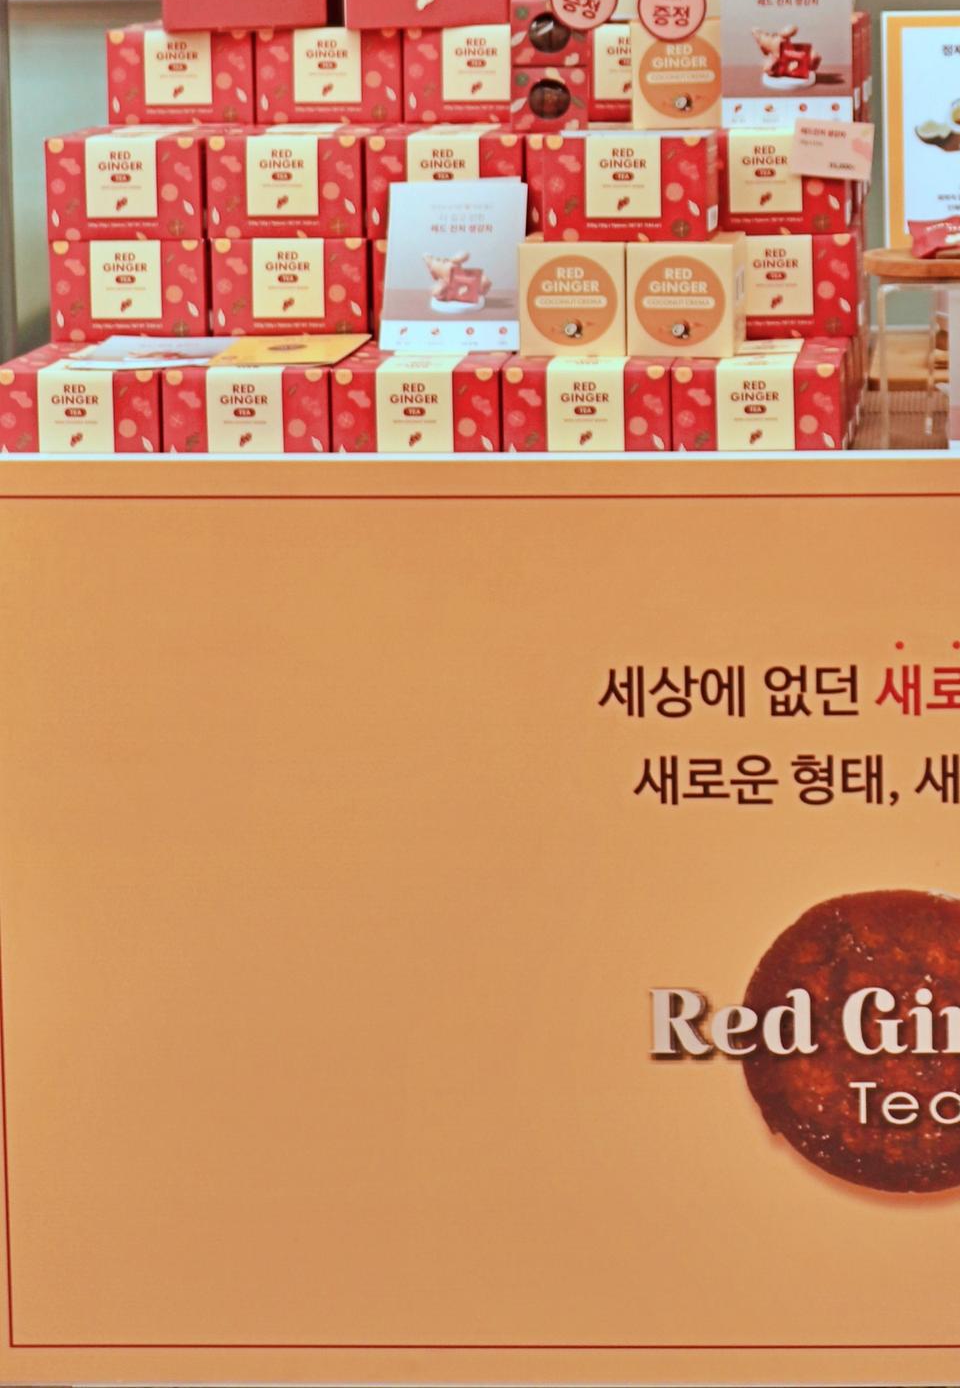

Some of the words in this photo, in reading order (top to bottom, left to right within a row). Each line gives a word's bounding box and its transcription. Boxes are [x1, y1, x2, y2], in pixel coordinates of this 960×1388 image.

[653, 5, 690, 26] 증정
[167, 41, 188, 50] RED
[317, 40, 337, 49] RED
[466, 38, 487, 46] RED
[617, 37, 632, 46] RE
[156, 51, 199, 60] GINGER
[305, 49, 348, 58] GINGER
[455, 47, 497, 57] GINGER
[666, 45, 693, 56] RED
[652, 56, 707, 68] GINGER
[109, 151, 131, 160] RED
[271, 149, 292, 158] RED
[432, 149, 454, 158] RED
[612, 148, 634, 157] RED
[754, 146, 775, 155] RED
[98, 161, 143, 171] GINGER
[259, 159, 304, 169] GINGER
[420, 158, 466, 169] GINGER
[600, 158, 646, 168] GINGER
[742, 156, 788, 166] GINGER
[114, 253, 136, 261] RED
[276, 251, 298, 260] RED
[764, 248, 786, 258] RED
[102, 262, 148, 272] GINGER
[265, 261, 310, 271] GINGER
[752, 258, 798, 269] GINGER
[557, 267, 585, 279] RED
[665, 268, 693, 280] RED
[542, 280, 599, 292] GINGER
[650, 281, 708, 293] GINGER
[64, 384, 86, 394] RED
[232, 384, 255, 394] RED
[403, 383, 425, 393] RED
[573, 382, 596, 392] RED
[743, 381, 766, 391] RED
[51, 395, 99, 405] GINGER
[220, 394, 268, 405] GINGER
[389, 393, 439, 404] GINGER
[560, 392, 610, 403] GINGER
[730, 391, 780, 402] GINGER
[598, 664, 746, 718] 세상에
[762, 664, 861, 717] 없던
[634, 755, 779, 806] 새로운
[791, 754, 900, 807] 형태,
[648, 987, 818, 1059] Red
